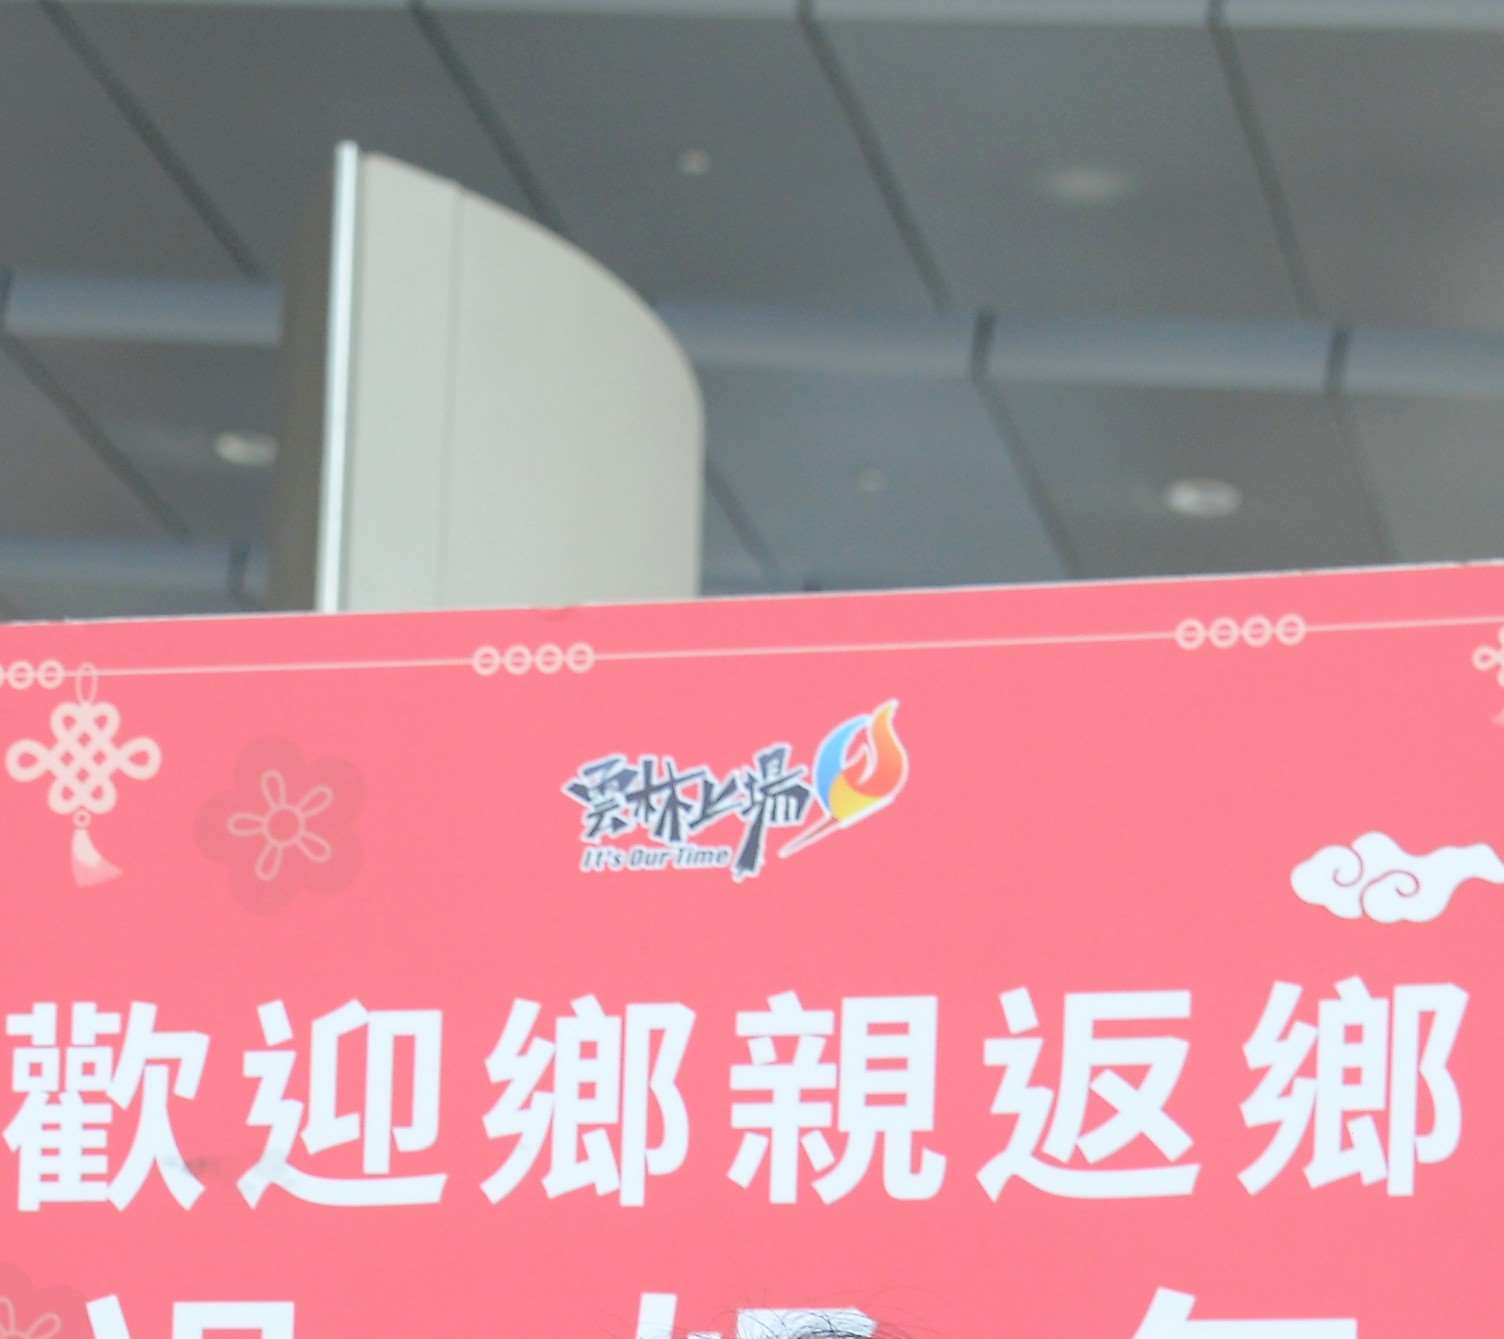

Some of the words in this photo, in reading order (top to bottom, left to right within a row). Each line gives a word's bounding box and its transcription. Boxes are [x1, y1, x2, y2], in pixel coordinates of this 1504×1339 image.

[3, 976, 1469, 1212] 歡迎鄉親返鄉
